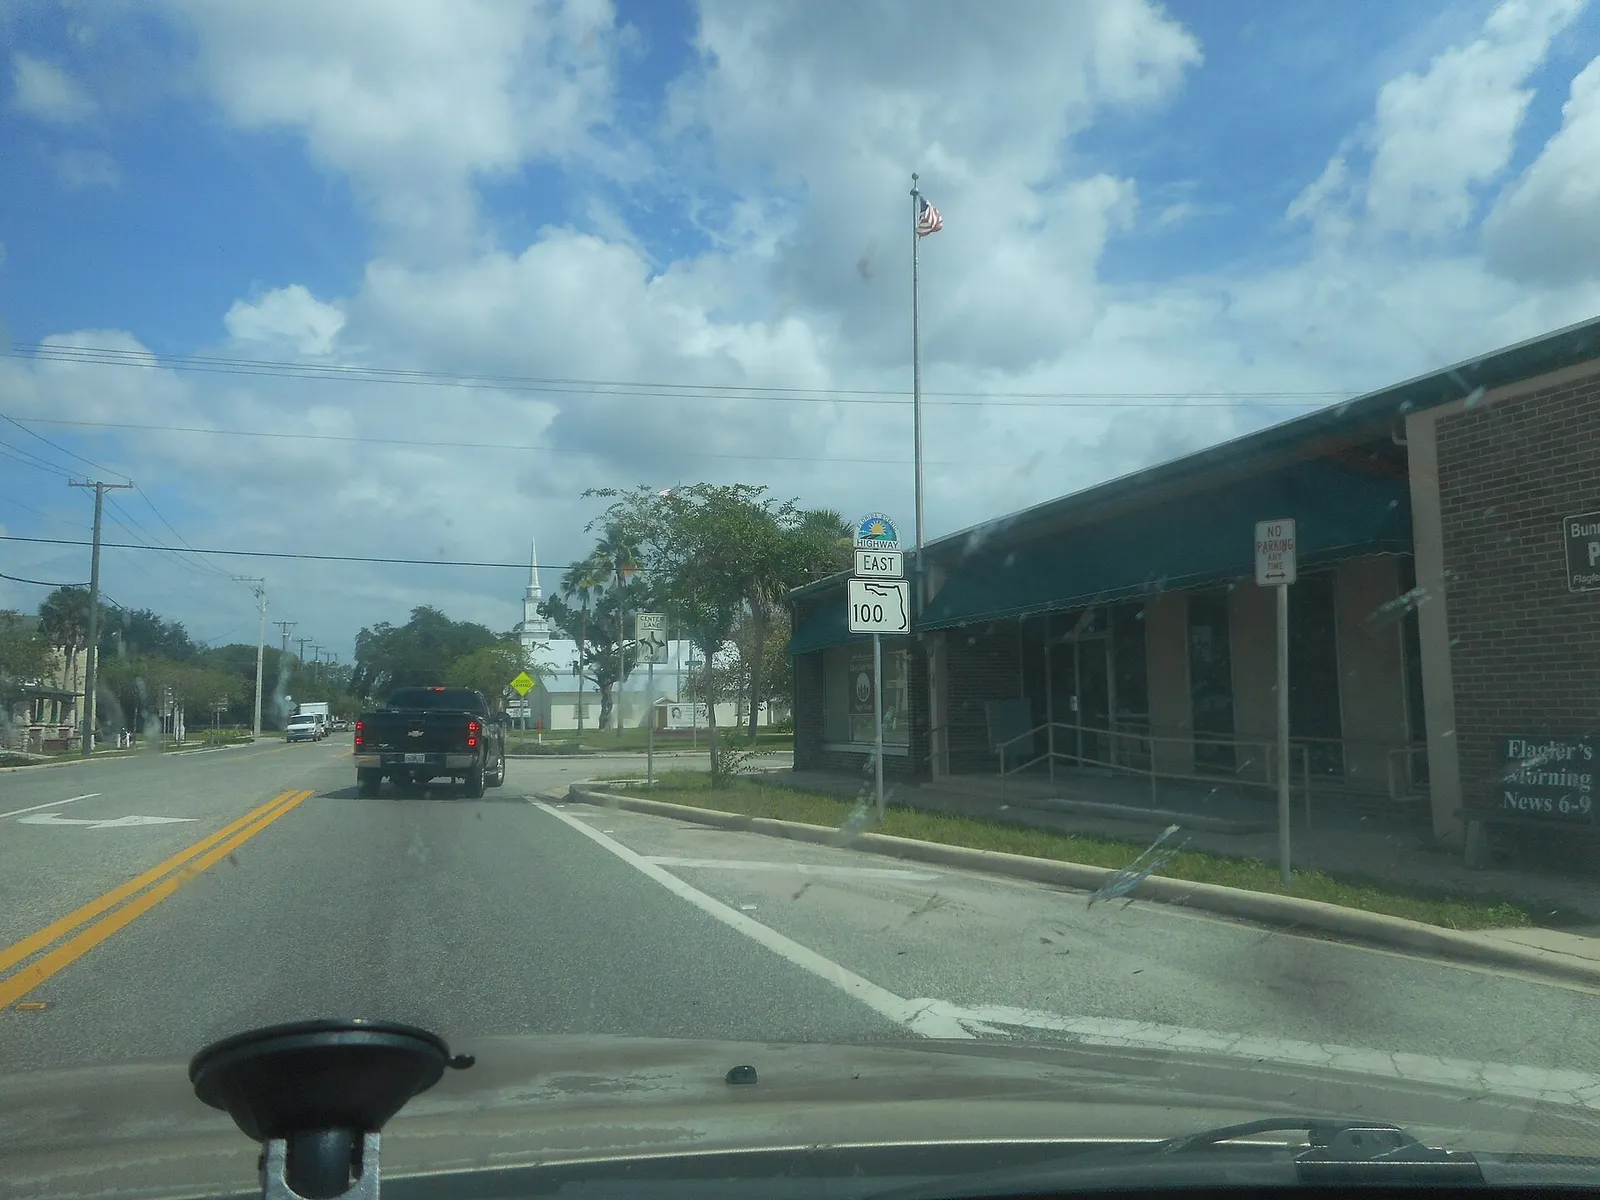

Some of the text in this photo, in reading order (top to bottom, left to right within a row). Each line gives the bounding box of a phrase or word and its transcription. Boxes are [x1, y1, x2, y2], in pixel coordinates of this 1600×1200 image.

[1267, 525, 1282, 537] NO
[857, 539, 898, 549] HIGHWAY
[1257, 538, 1293, 554] PARKING
[863, 555, 895, 571] EAST
[1268, 552, 1282, 561] ANY
[1267, 561, 1284, 571] TIME
[853, 603, 883, 623] 100
[1503, 791, 1592, 814] News 6-9
